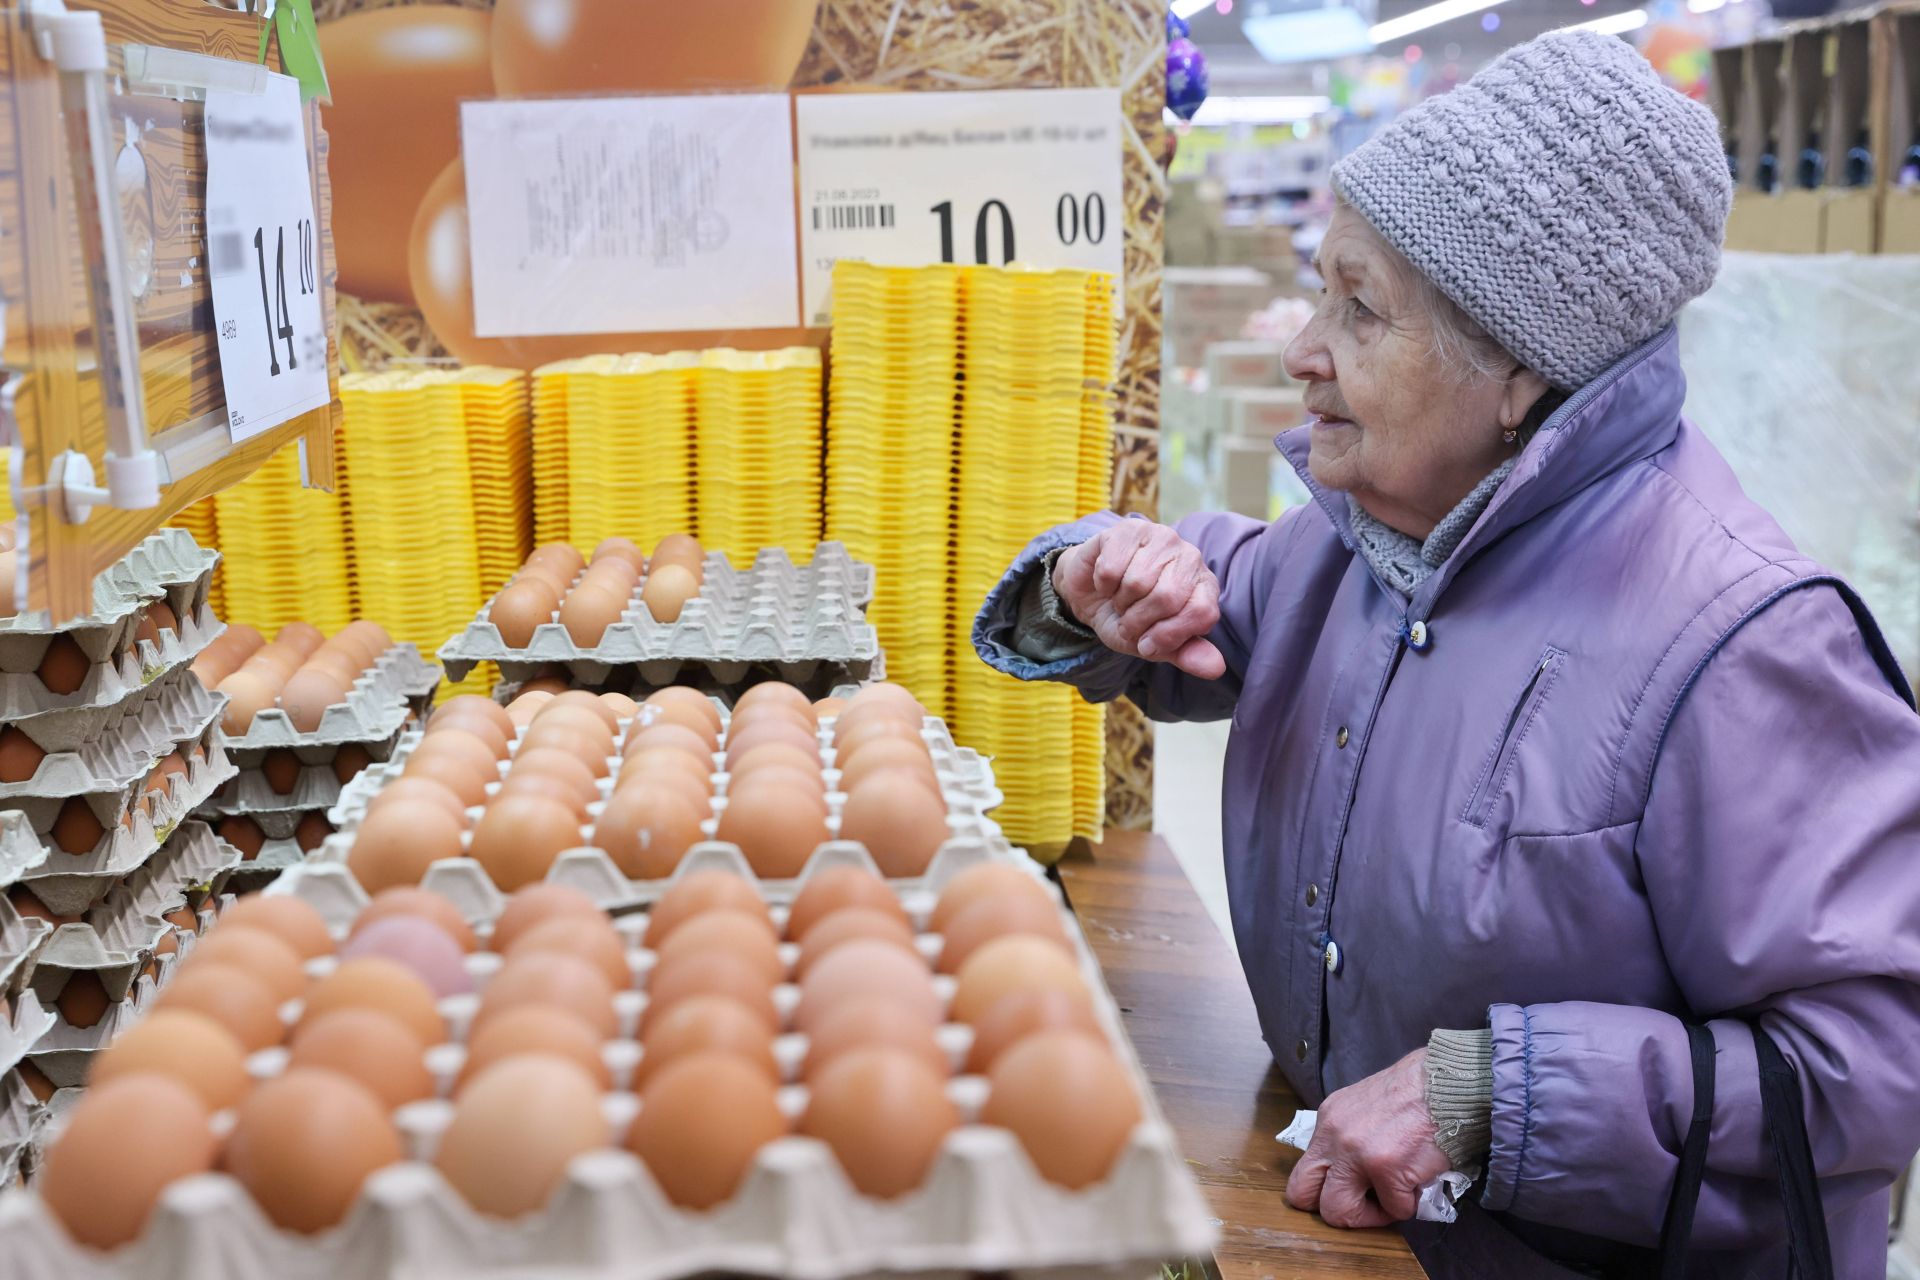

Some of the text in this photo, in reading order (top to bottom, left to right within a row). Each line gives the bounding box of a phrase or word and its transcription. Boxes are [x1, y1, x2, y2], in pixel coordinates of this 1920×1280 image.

[930, 192, 1106, 265] 10 00
[254, 226, 298, 377] 14
[297, 218, 315, 295] 10
